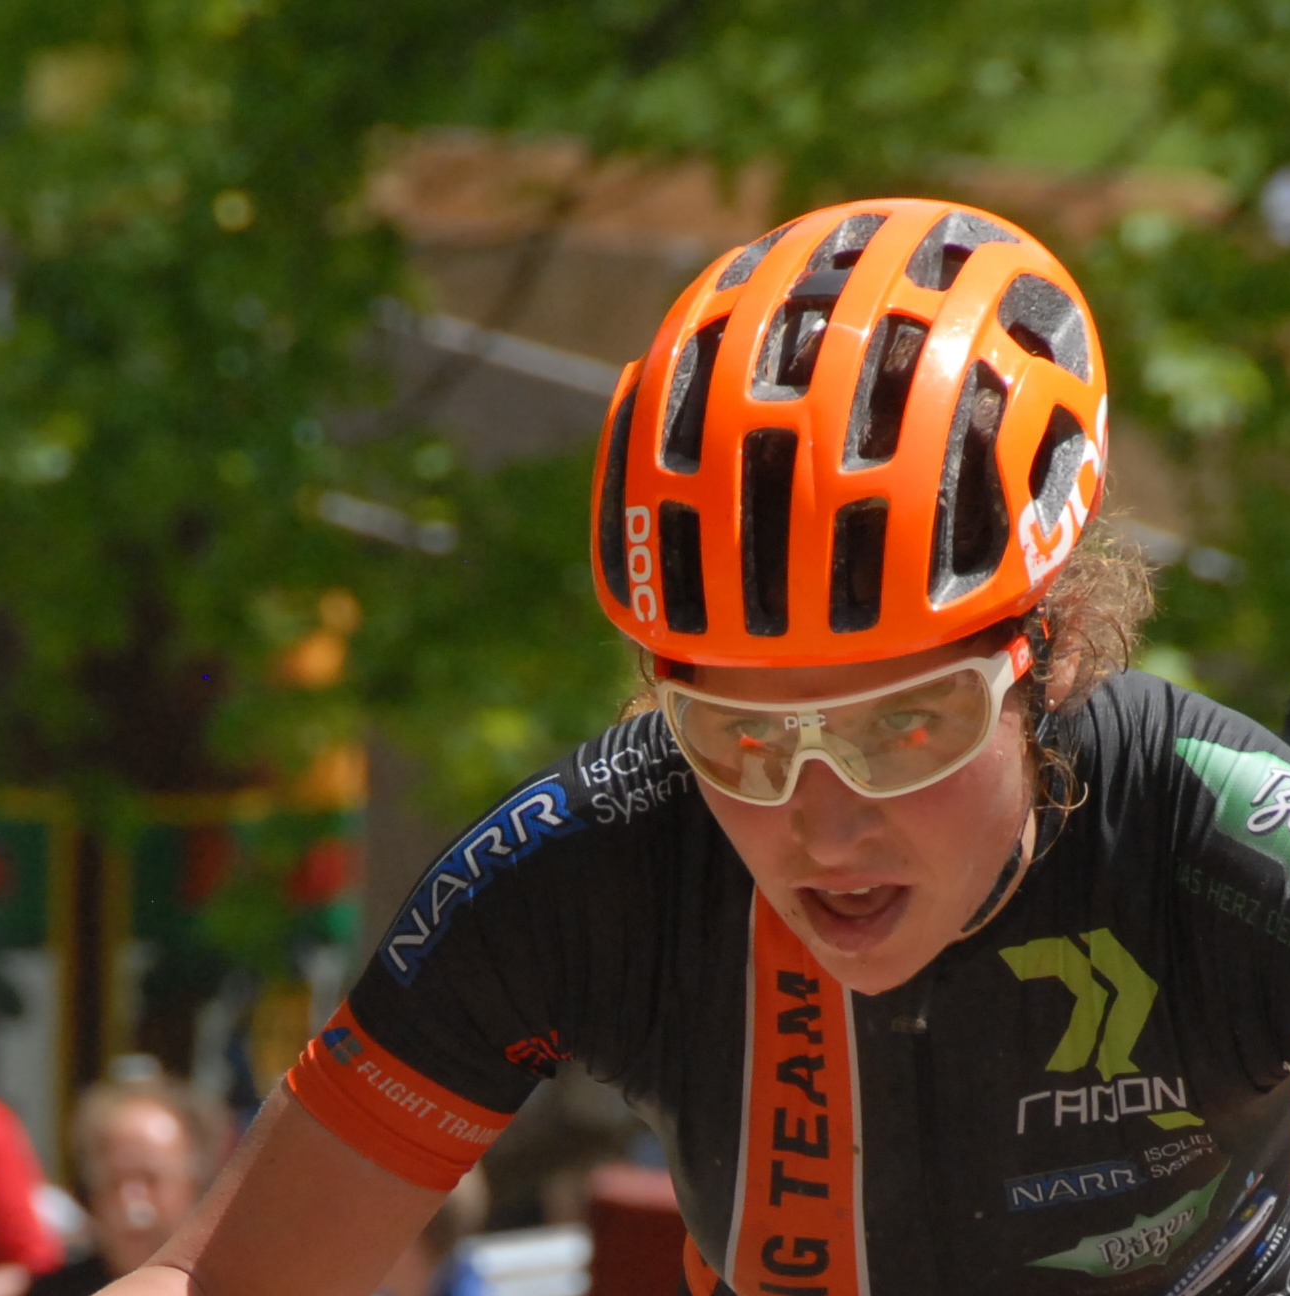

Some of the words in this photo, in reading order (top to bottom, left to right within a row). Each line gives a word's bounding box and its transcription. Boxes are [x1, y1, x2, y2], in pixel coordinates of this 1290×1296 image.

[624, 504, 658, 624] POC
[388, 792, 566, 973] NARR
[357, 1060, 437, 1119] FLIGHT
[768, 970, 830, 1207] TEAM
[1011, 1168, 1137, 1206] NARR
[1098, 1207, 1195, 1271] Bitzer
